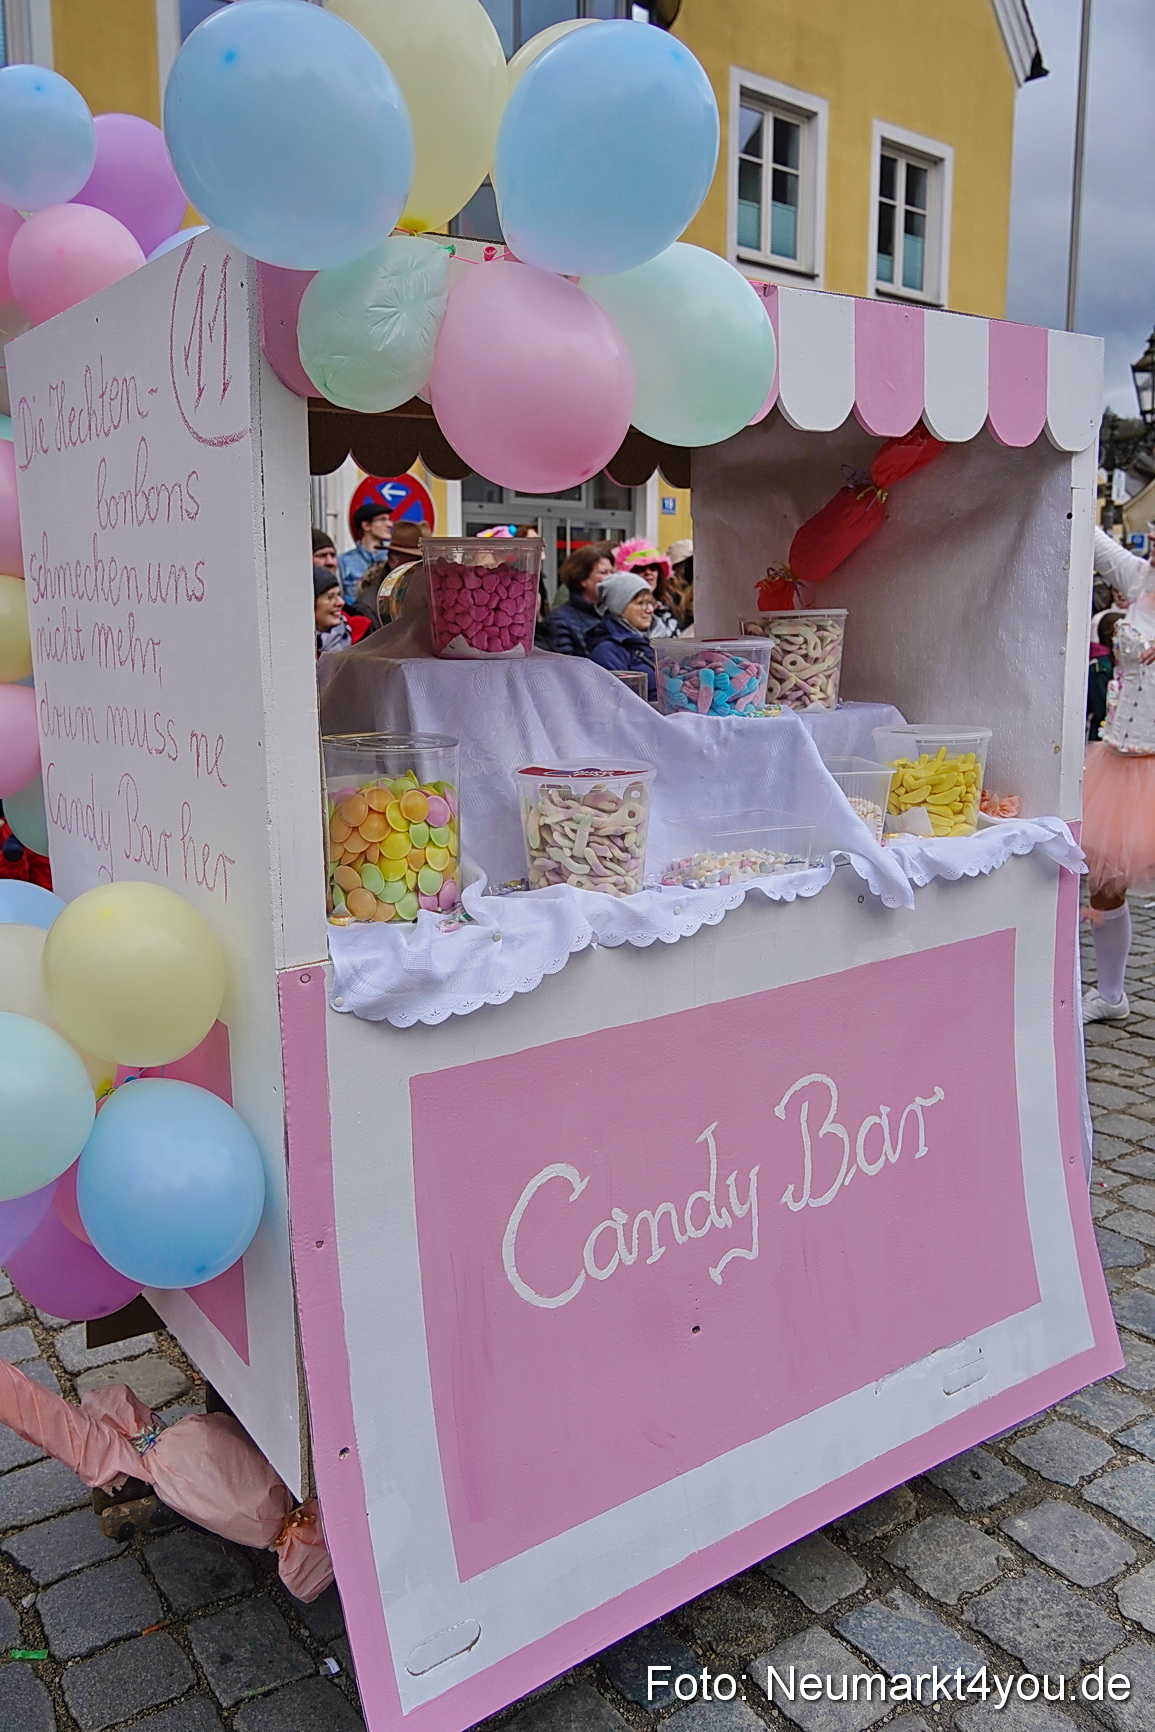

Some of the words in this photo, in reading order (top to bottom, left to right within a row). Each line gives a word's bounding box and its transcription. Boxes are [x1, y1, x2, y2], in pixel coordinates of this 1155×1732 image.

[184, 255, 232, 411] 11
[18, 395, 49, 472] Die
[97, 436, 200, 530] bonbons
[30, 531, 142, 606] schmecken
[147, 559, 206, 605] uns
[36, 606, 85, 664] nicht
[91, 611, 162, 689] mehr,
[39, 680, 99, 744] drum
[106, 705, 178, 761] muss
[190, 729, 227, 788] ne
[45, 762, 114, 882] Candy
[117, 772, 173, 878] Bar
[180, 801, 236, 904] her
[502, 1121, 761, 1309] Candy
[774, 1073, 945, 1211] Bar
